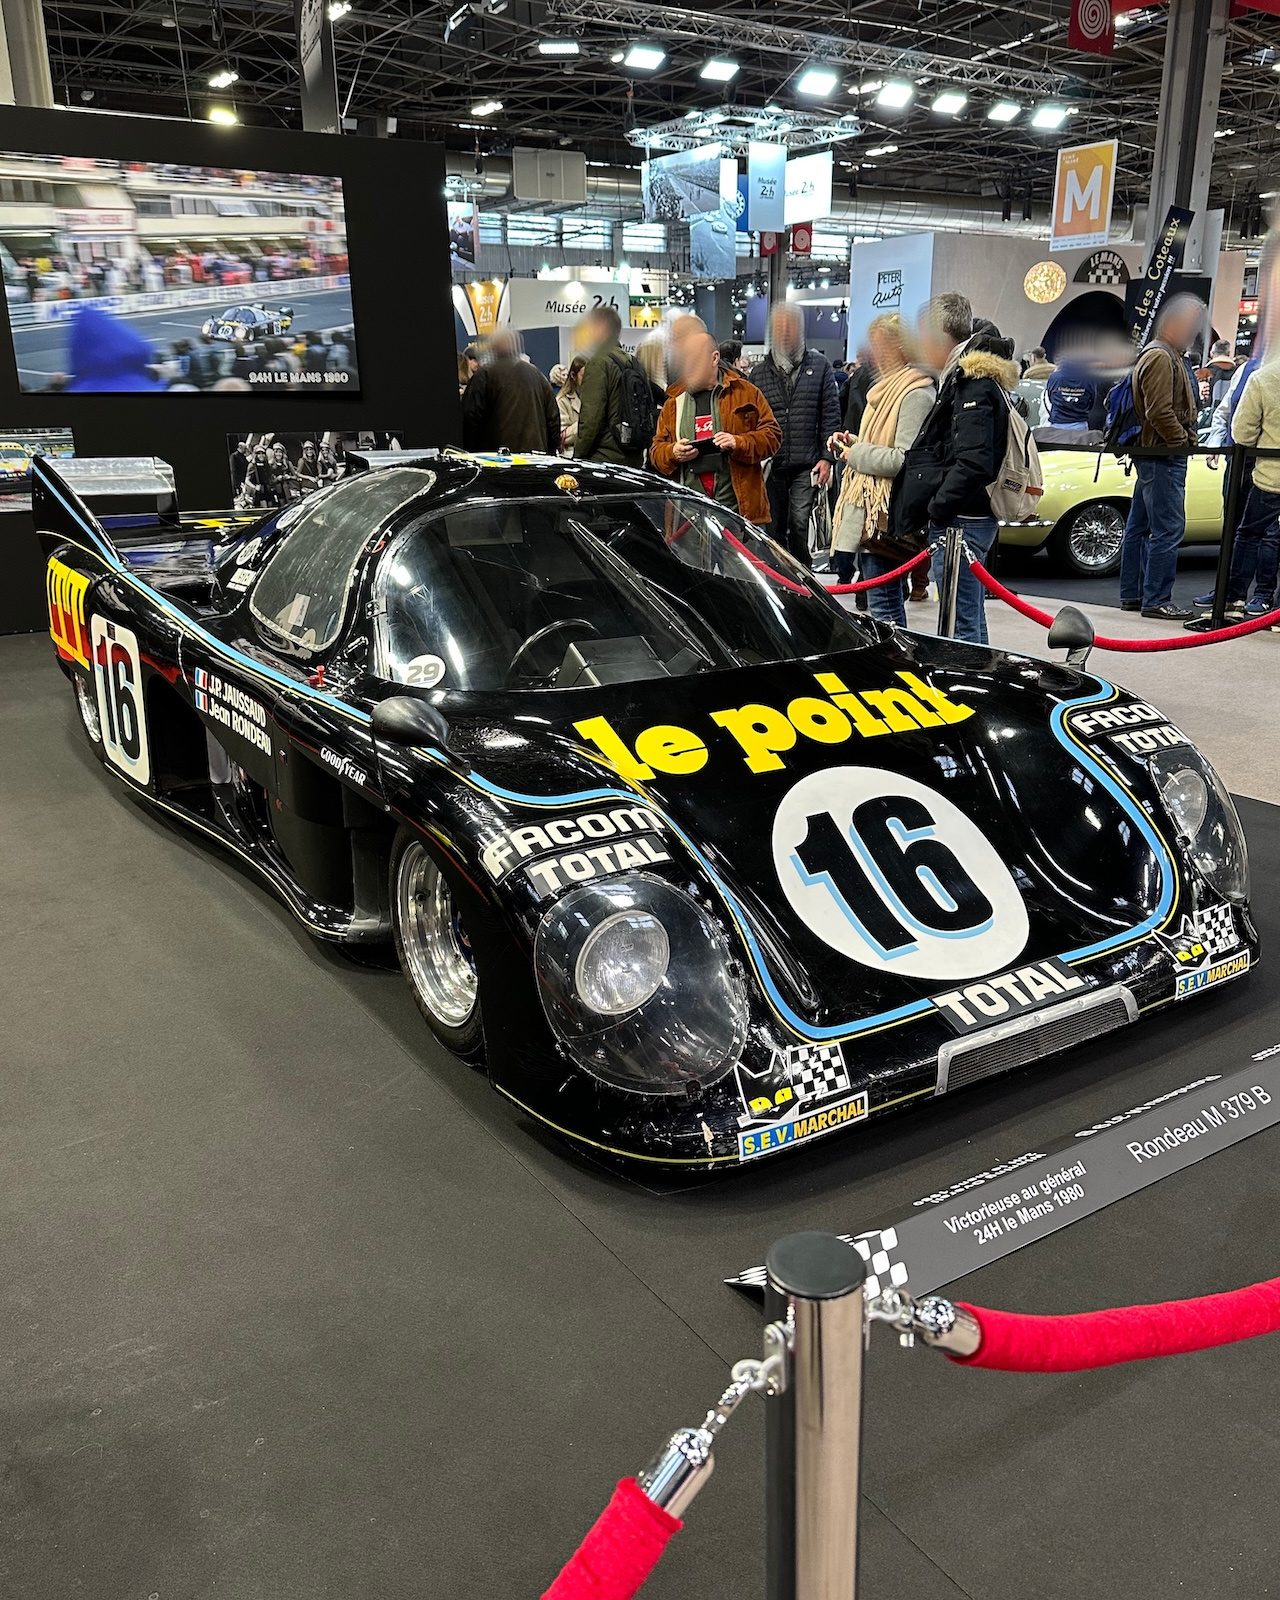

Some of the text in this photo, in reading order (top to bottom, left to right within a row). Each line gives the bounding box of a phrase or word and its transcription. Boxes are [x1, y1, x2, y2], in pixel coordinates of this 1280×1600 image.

[1063, 165, 1104, 224] M
[878, 272, 901, 284] PETER
[1090, 251, 1123, 269] LE MANS
[1135, 288, 1154, 317] des
[1147, 218, 1180, 281] Coteaux
[1157, 265, 1173, 294] passion
[545, 300, 587, 313] Musée
[249, 372, 349, 383] 24H LE MANS 1980
[95, 632, 141, 766] 16
[208, 674, 267, 728] J.P. JAUSSAUD
[406, 662, 440, 684] 29
[208, 697, 272, 757] Jean RONDEAU
[572, 671, 976, 780] le point
[320, 746, 368, 786] GOODYEAR
[483, 807, 666, 880] FACOM
[529, 838, 671, 891] TOTAL
[790, 794, 994, 961] 16
[931, 960, 1086, 1026] TOTAL
[1178, 954, 1248, 995] S.E.V. MARCHAL
[743, 1099, 865, 1155] S.E.V. MARCHAL
[1126, 1085, 1272, 1164] Rondeau M 379 B
[943, 1160, 1088, 1235] Victorieuse au général
[973, 1183, 1086, 1246] 24H le Mans 1980
